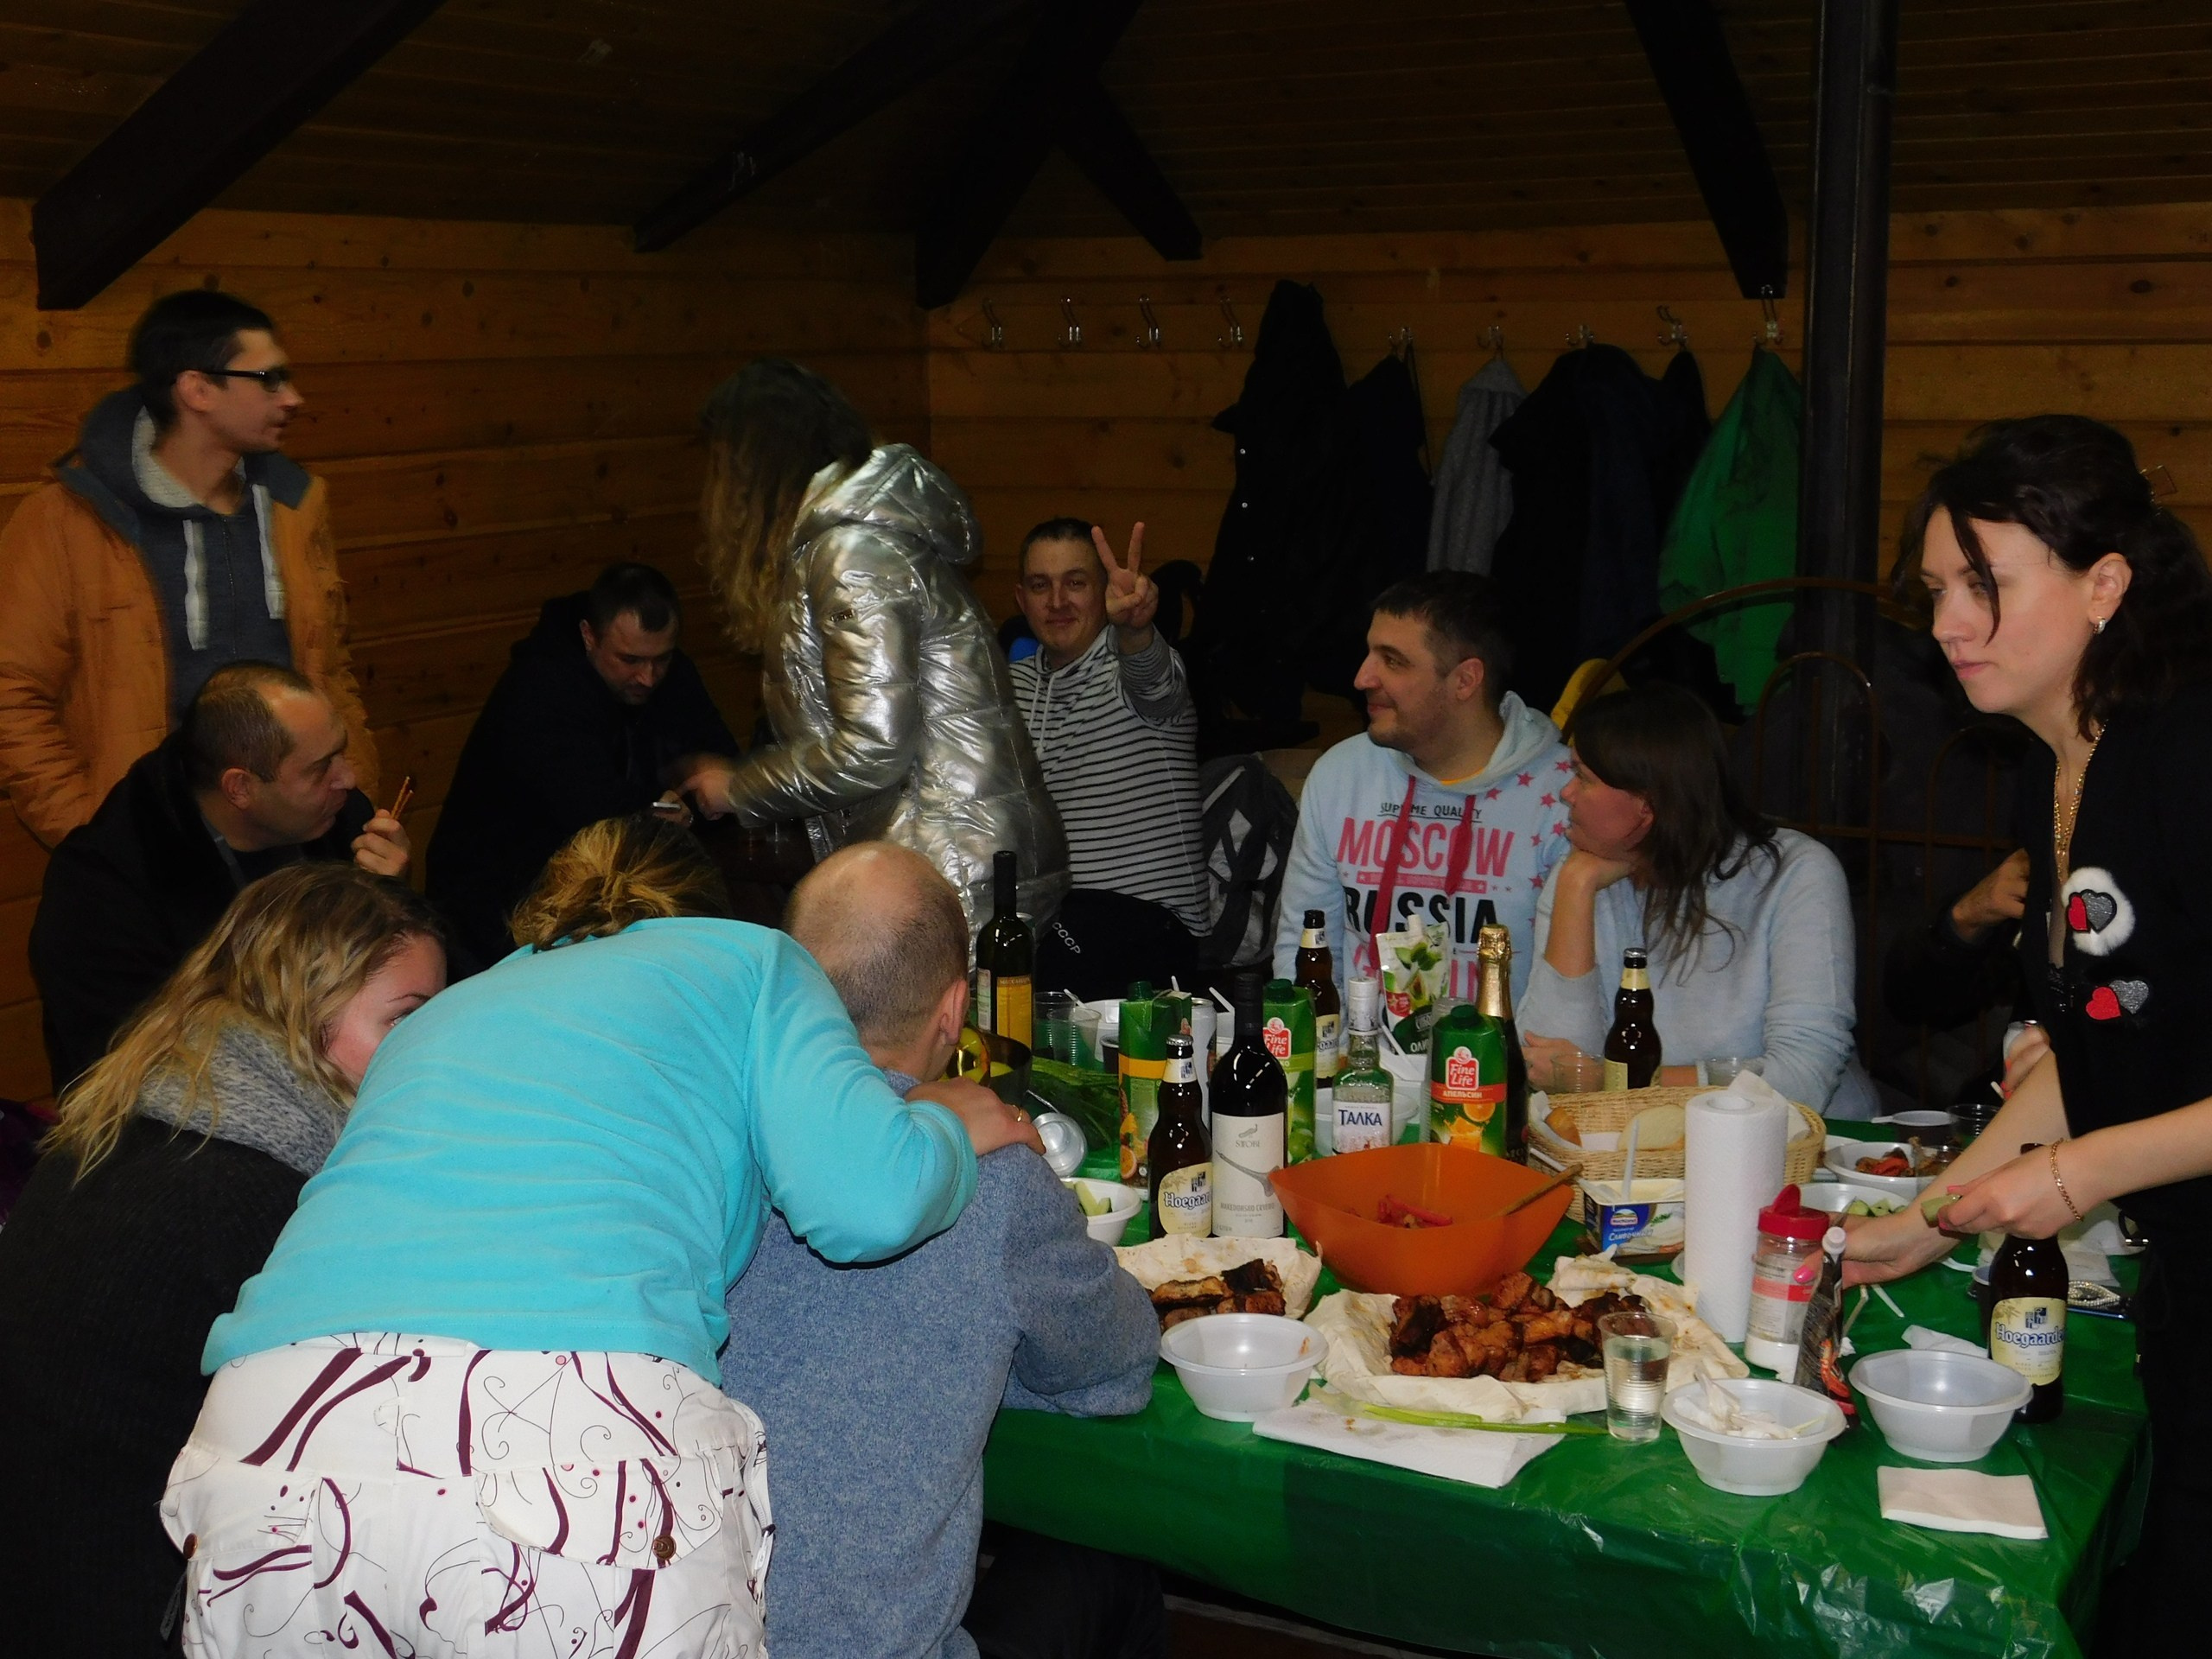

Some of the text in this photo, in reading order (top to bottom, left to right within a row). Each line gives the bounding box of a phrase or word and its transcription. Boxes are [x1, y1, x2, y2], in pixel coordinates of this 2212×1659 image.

[1380, 802, 1483, 819] SUPME QUALY
[1337, 817, 1516, 877] MOSCW
[1265, 1033, 1287, 1045] Fine
[1450, 1064, 1475, 1076] Fine
[1452, 1074, 1473, 1086] Life
[1338, 1109, 1382, 1126] ТАЛКА
